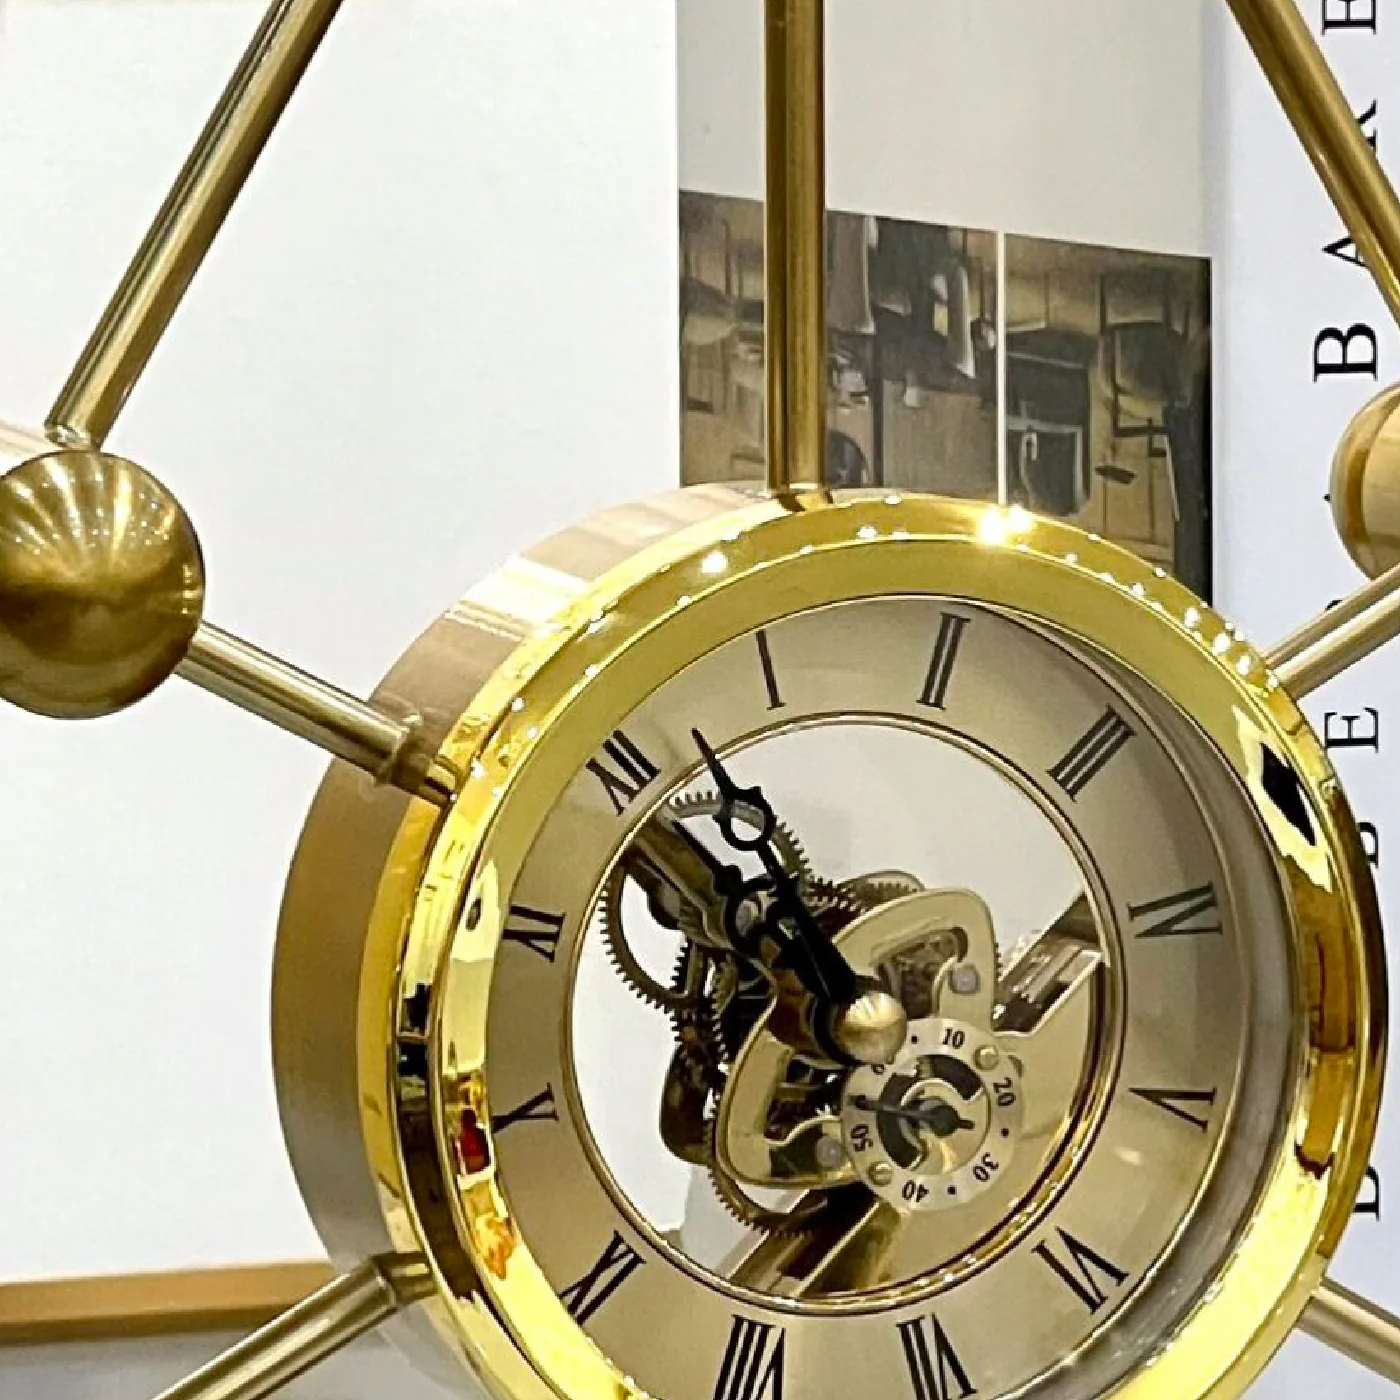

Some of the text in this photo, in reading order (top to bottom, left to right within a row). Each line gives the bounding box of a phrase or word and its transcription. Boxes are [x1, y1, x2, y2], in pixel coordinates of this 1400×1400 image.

[916, 611, 971, 710] II
[1045, 702, 1138, 802] III
[942, 1028, 966, 1050] 10
[992, 1076, 1017, 1107] 20
[1128, 1086, 1218, 1133] V
[972, 1151, 999, 1182] 30
[901, 1179, 930, 1203] 40
[1031, 1226, 1130, 1316] VI
